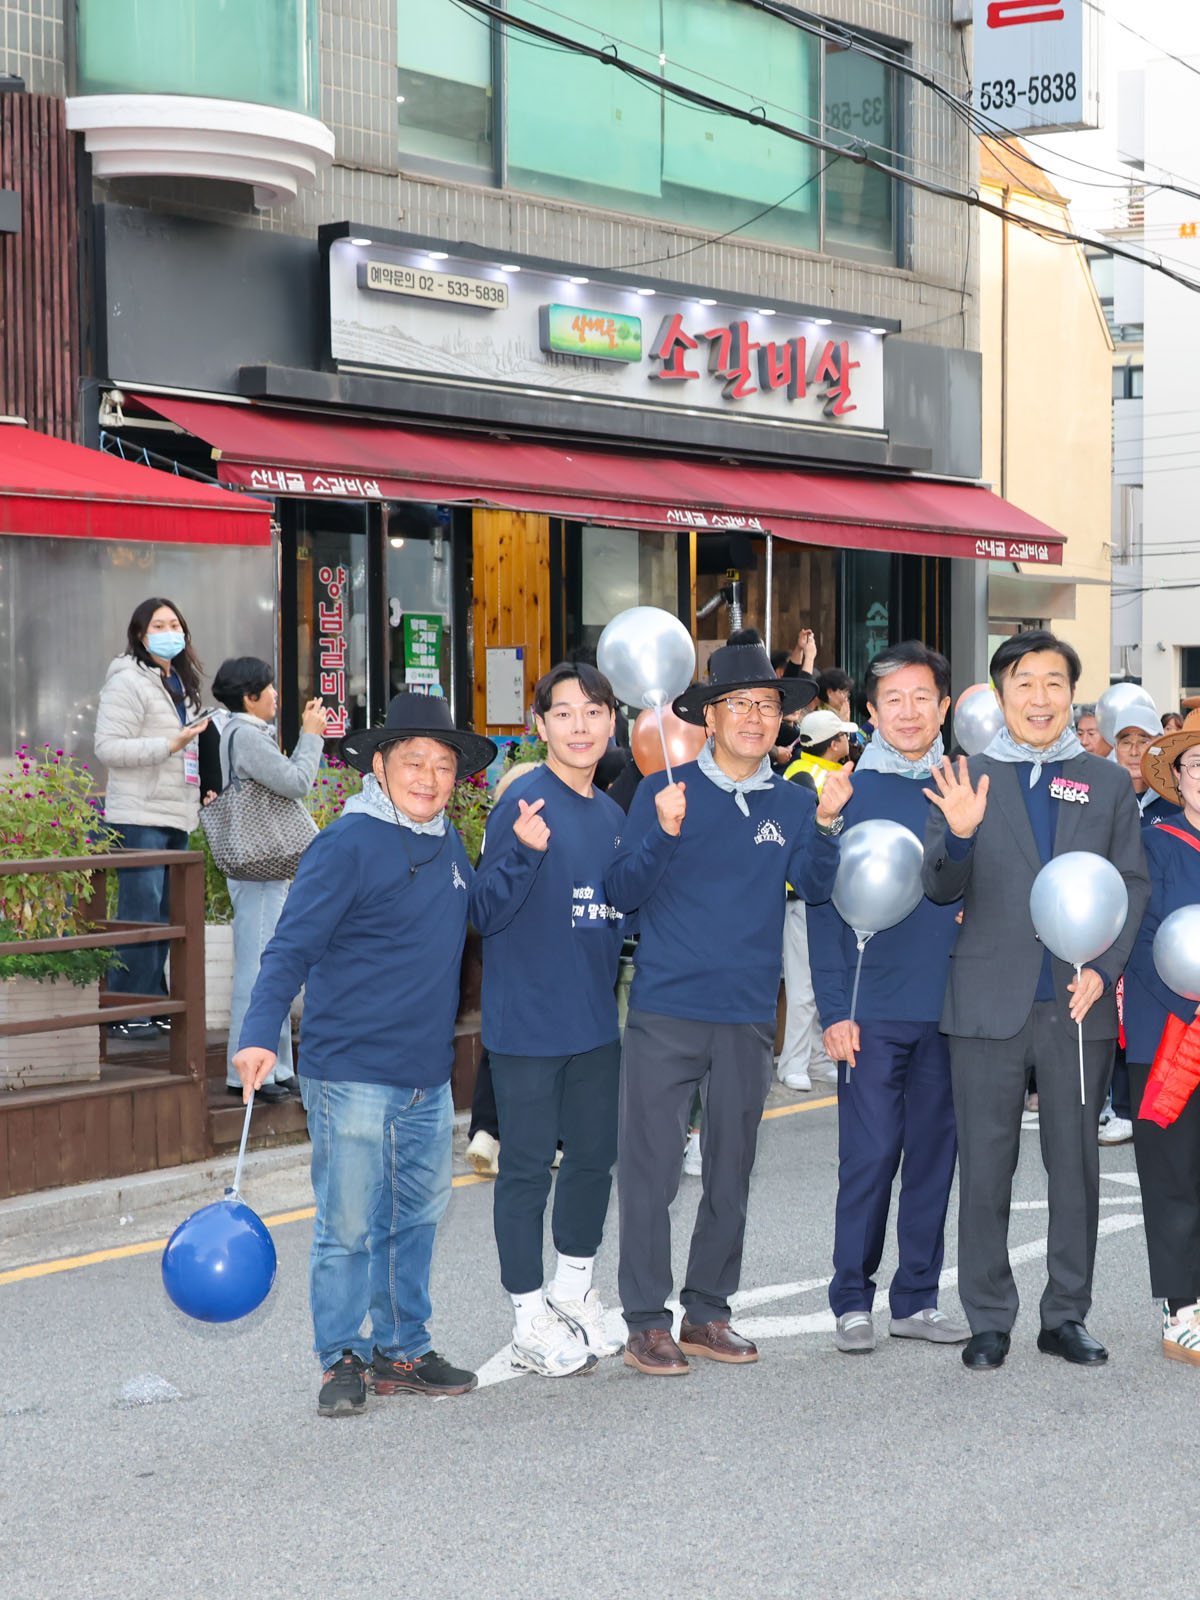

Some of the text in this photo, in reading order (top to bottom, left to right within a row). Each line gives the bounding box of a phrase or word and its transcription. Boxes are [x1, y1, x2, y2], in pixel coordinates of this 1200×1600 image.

[981, 71, 1077, 111] 533-5838
[371, 266, 415, 289] 예약문의
[419, 275, 434, 292] 02
[447, 280, 505, 303] 533-5838
[657, 313, 861, 416] 소갈비살
[251, 469, 383, 497] 산내골 소갈비살
[975, 539, 1049, 560] 산내골 소갈비살
[319, 567, 348, 738] 양념갈비살
